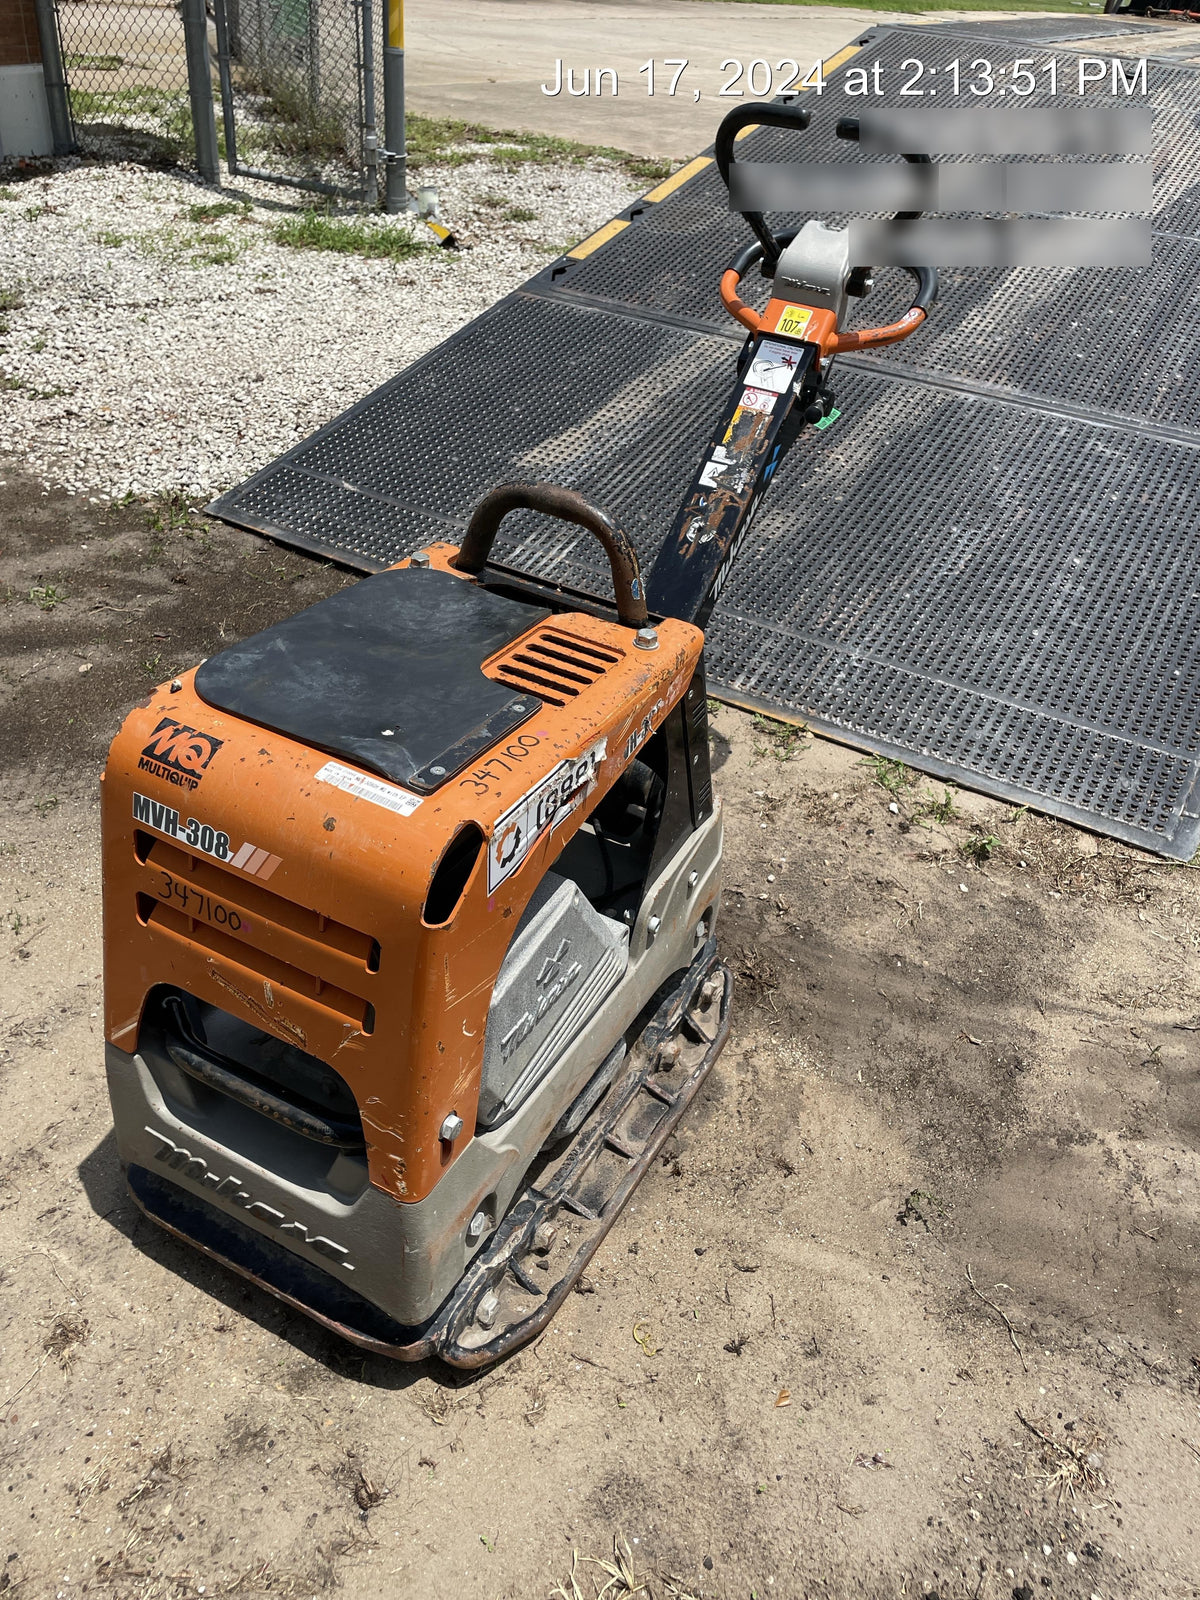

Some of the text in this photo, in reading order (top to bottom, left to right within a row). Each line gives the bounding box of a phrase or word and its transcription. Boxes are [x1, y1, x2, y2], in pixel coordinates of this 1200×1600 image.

[779, 318, 801, 333] 107
[137, 756, 199, 791] MULTIQUIP
[147, 722, 215, 772] MQ
[459, 734, 541, 796] 347100
[132, 793, 231, 861] MVH-308
[158, 871, 242, 931] 347100
